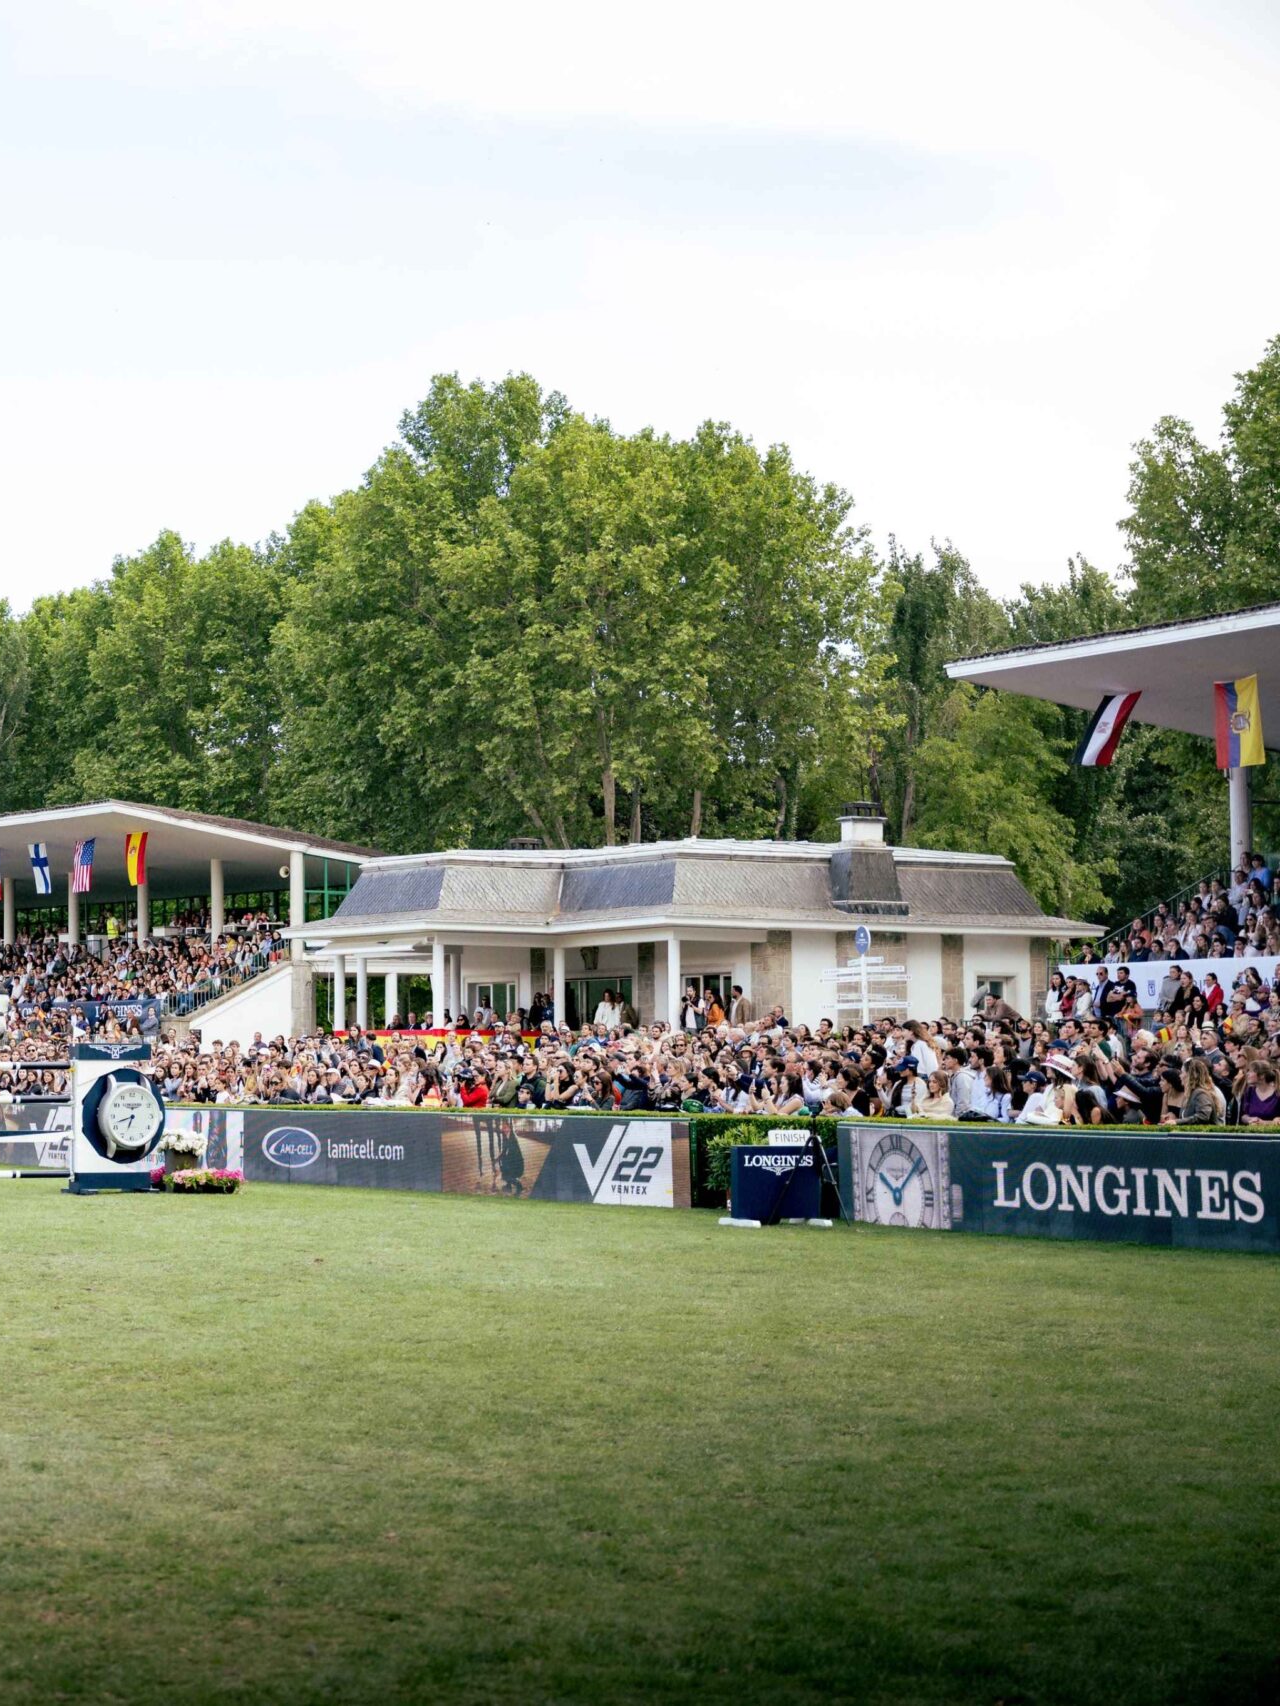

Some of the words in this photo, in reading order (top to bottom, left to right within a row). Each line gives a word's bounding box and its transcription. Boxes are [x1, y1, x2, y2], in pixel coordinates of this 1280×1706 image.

[774, 1133, 806, 1143] FINISH
[327, 1138, 405, 1161] lamicell.com
[611, 1184, 648, 1195] VENTEX
[992, 1161, 1265, 1224] LONGINES
